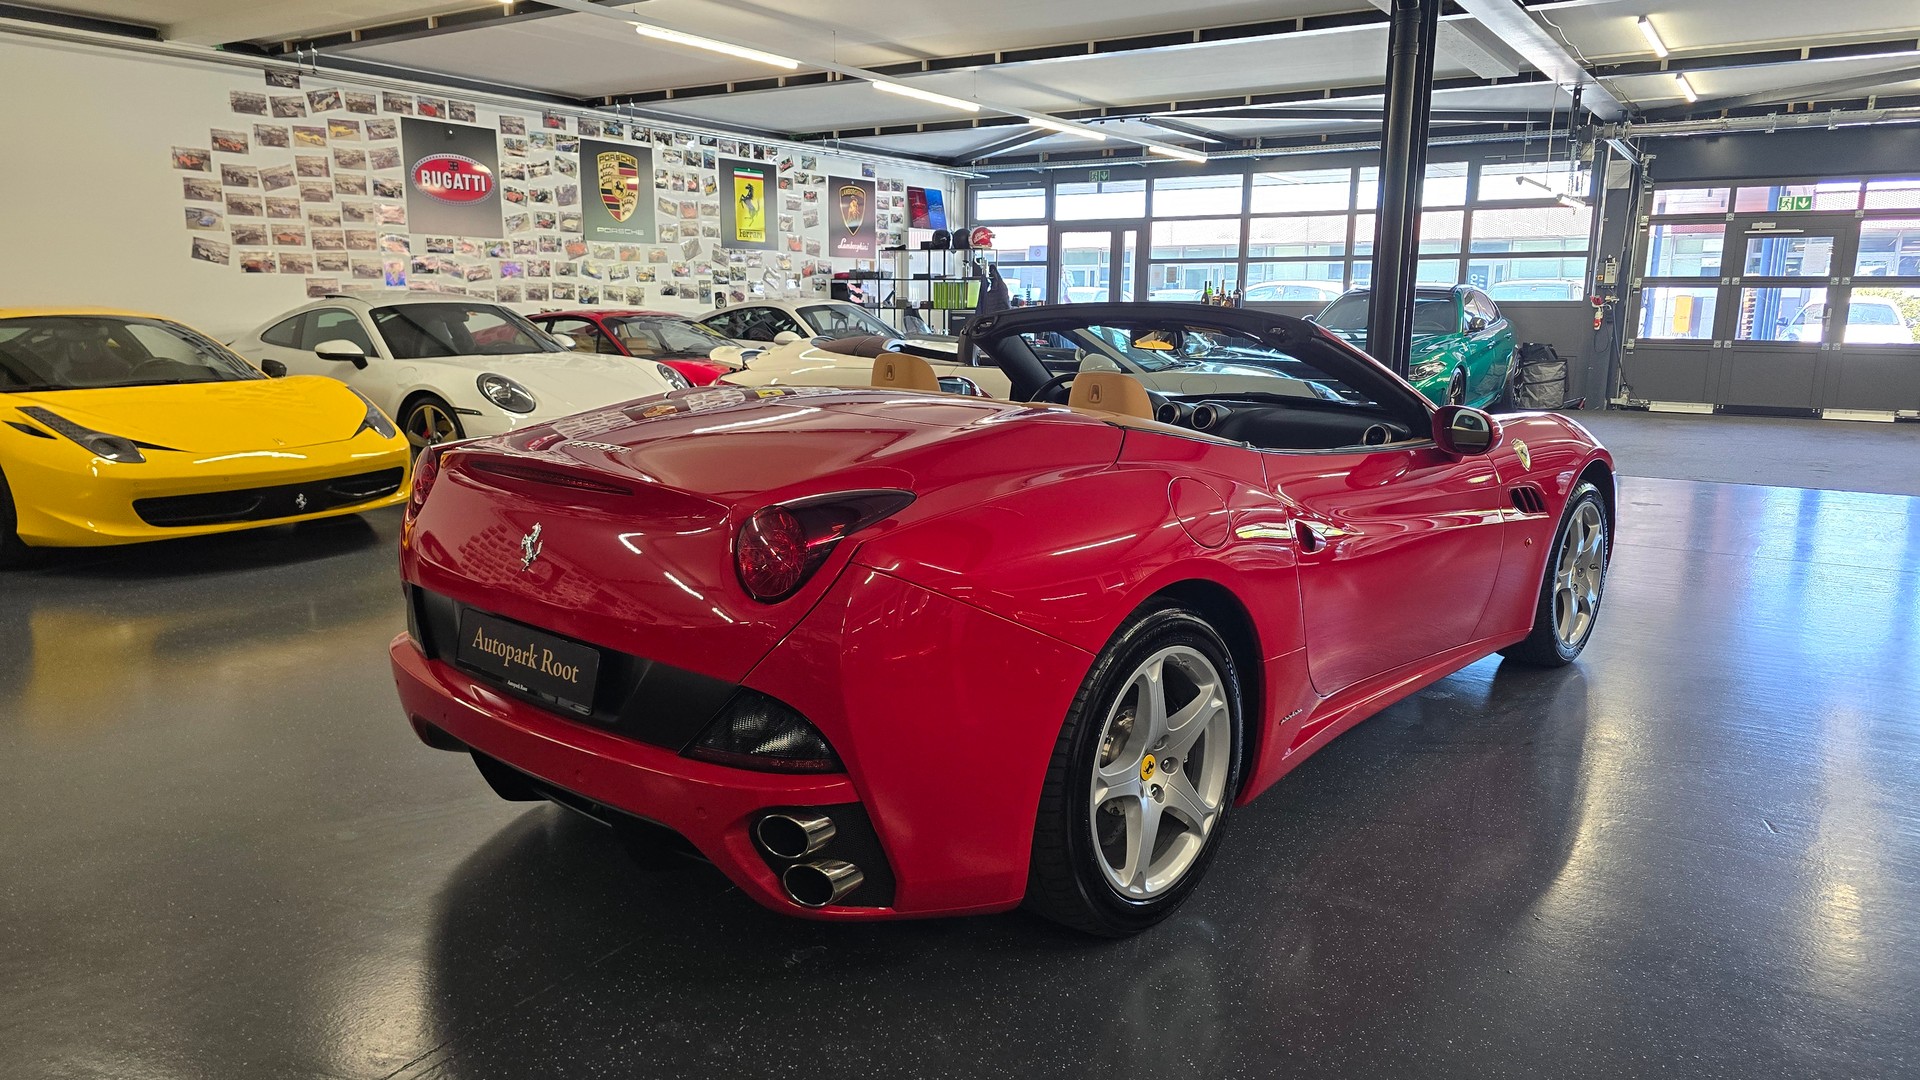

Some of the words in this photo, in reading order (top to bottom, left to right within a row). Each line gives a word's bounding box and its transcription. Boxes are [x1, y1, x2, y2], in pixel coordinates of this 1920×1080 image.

[599, 154, 636, 166] PORSCHE
[421, 169, 486, 192] BUGATTI
[597, 226, 645, 236] PORSCHE
[738, 228, 763, 239] Ferrari
[472, 626, 537, 669] Autopark
[540, 648, 580, 684] Root
